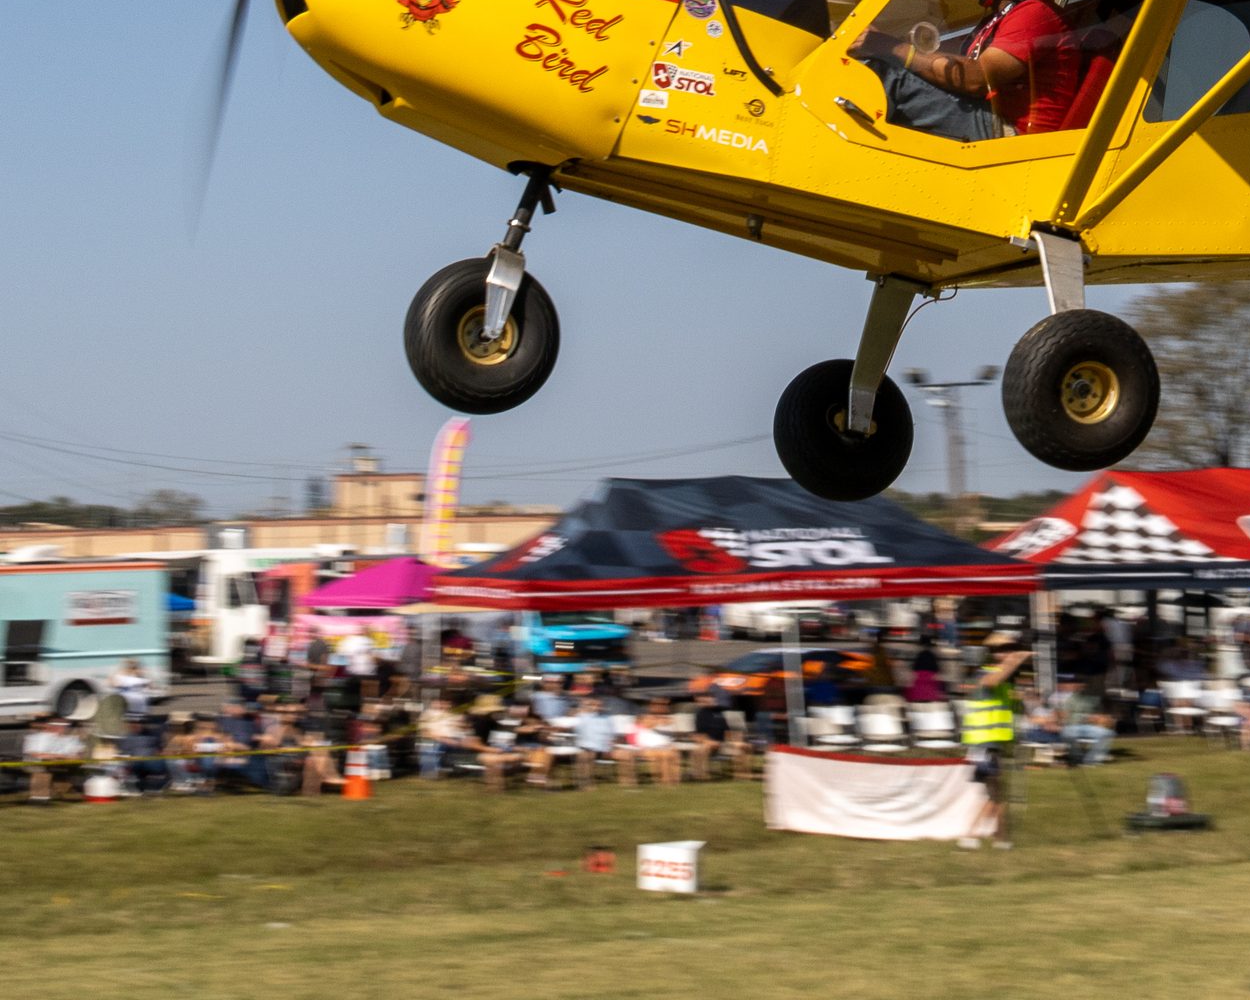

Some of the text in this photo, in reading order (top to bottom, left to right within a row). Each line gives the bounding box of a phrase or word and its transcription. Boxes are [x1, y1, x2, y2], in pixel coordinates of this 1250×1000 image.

[515, 23, 609, 93] Bird
[674, 77, 715, 96] STOL
[746, 539, 894, 568] STOL
